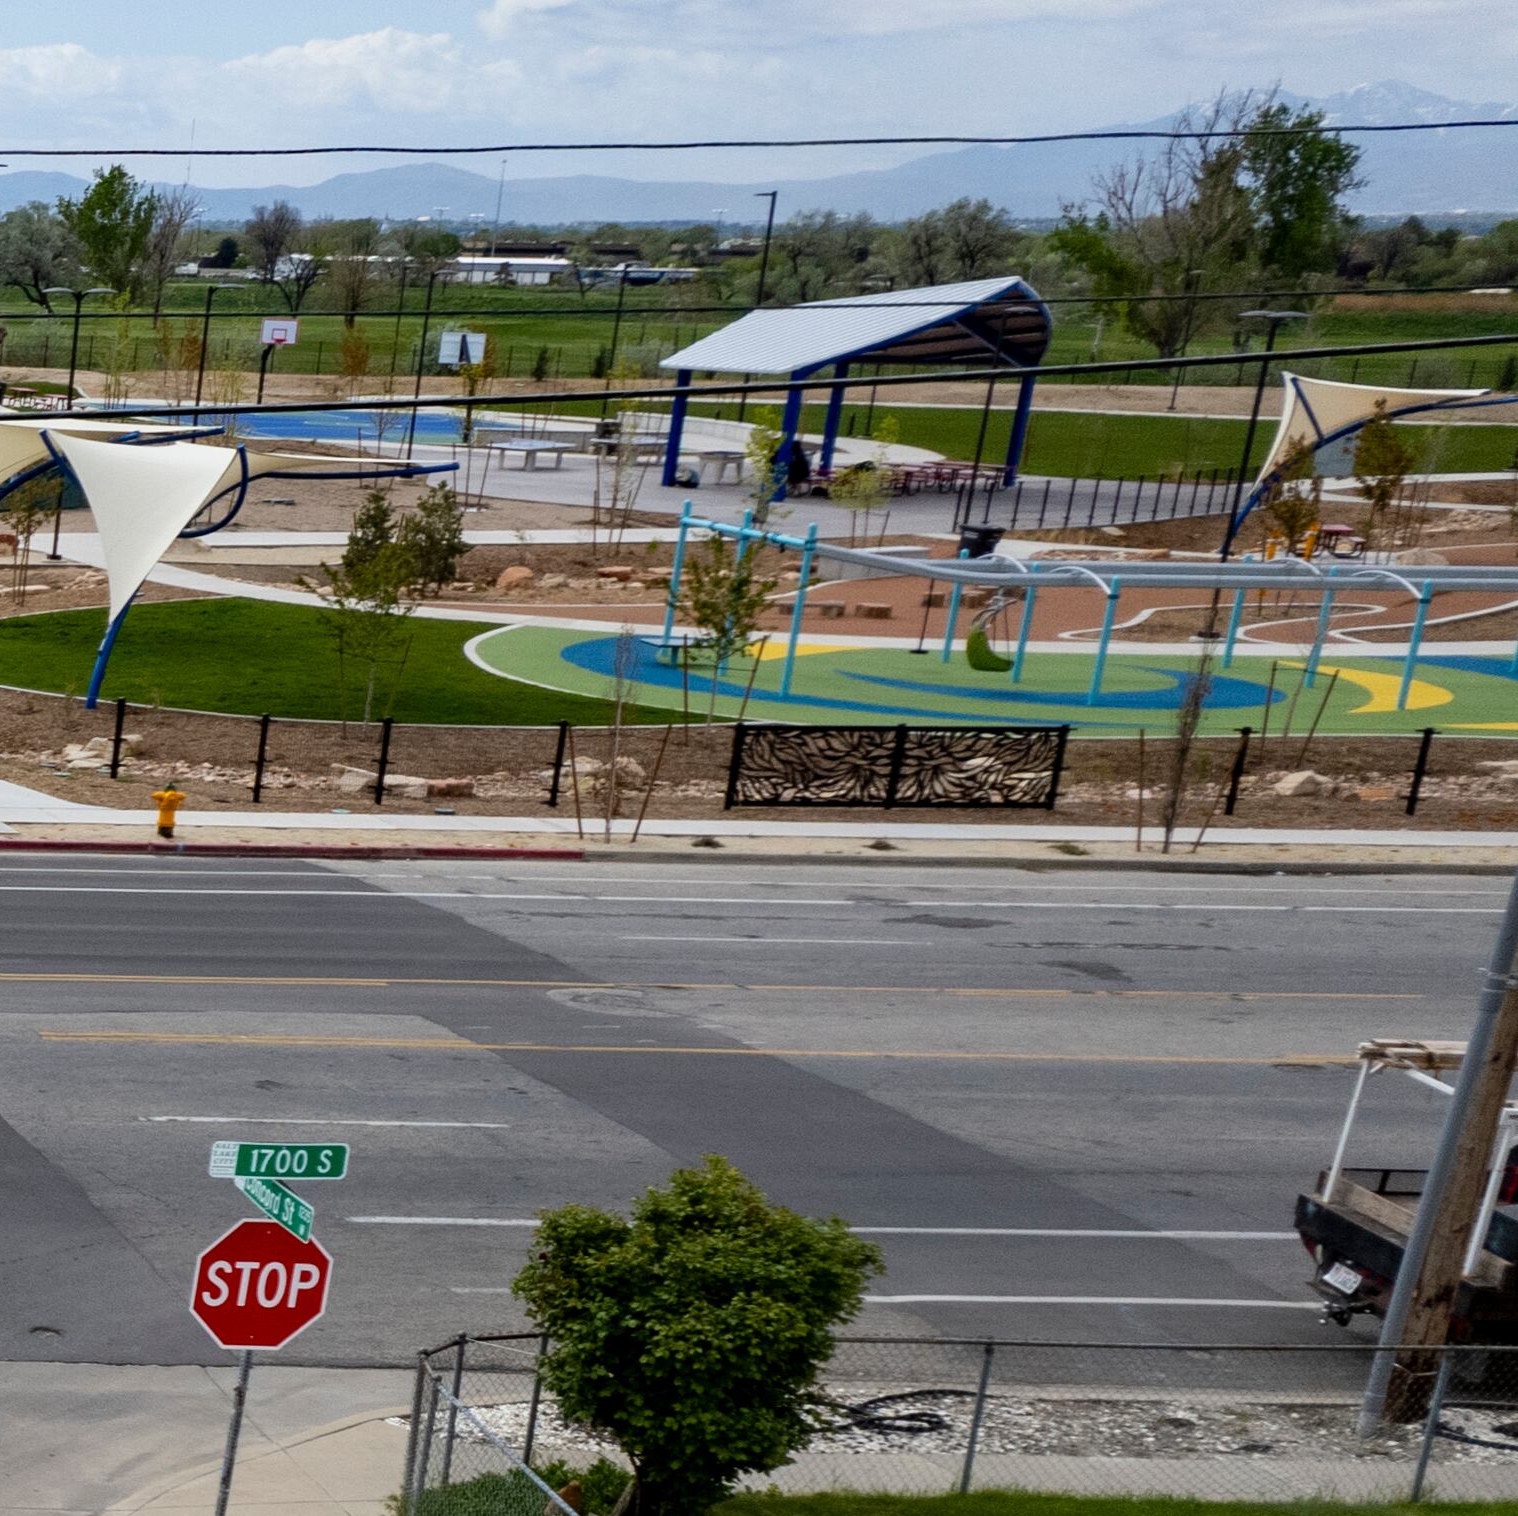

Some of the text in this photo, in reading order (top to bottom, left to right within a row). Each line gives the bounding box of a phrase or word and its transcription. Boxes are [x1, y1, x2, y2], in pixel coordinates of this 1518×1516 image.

[250, 1149, 333, 1174] 1700 S
[282, 1196, 296, 1226] St
[201, 1260, 321, 1309] STOP
